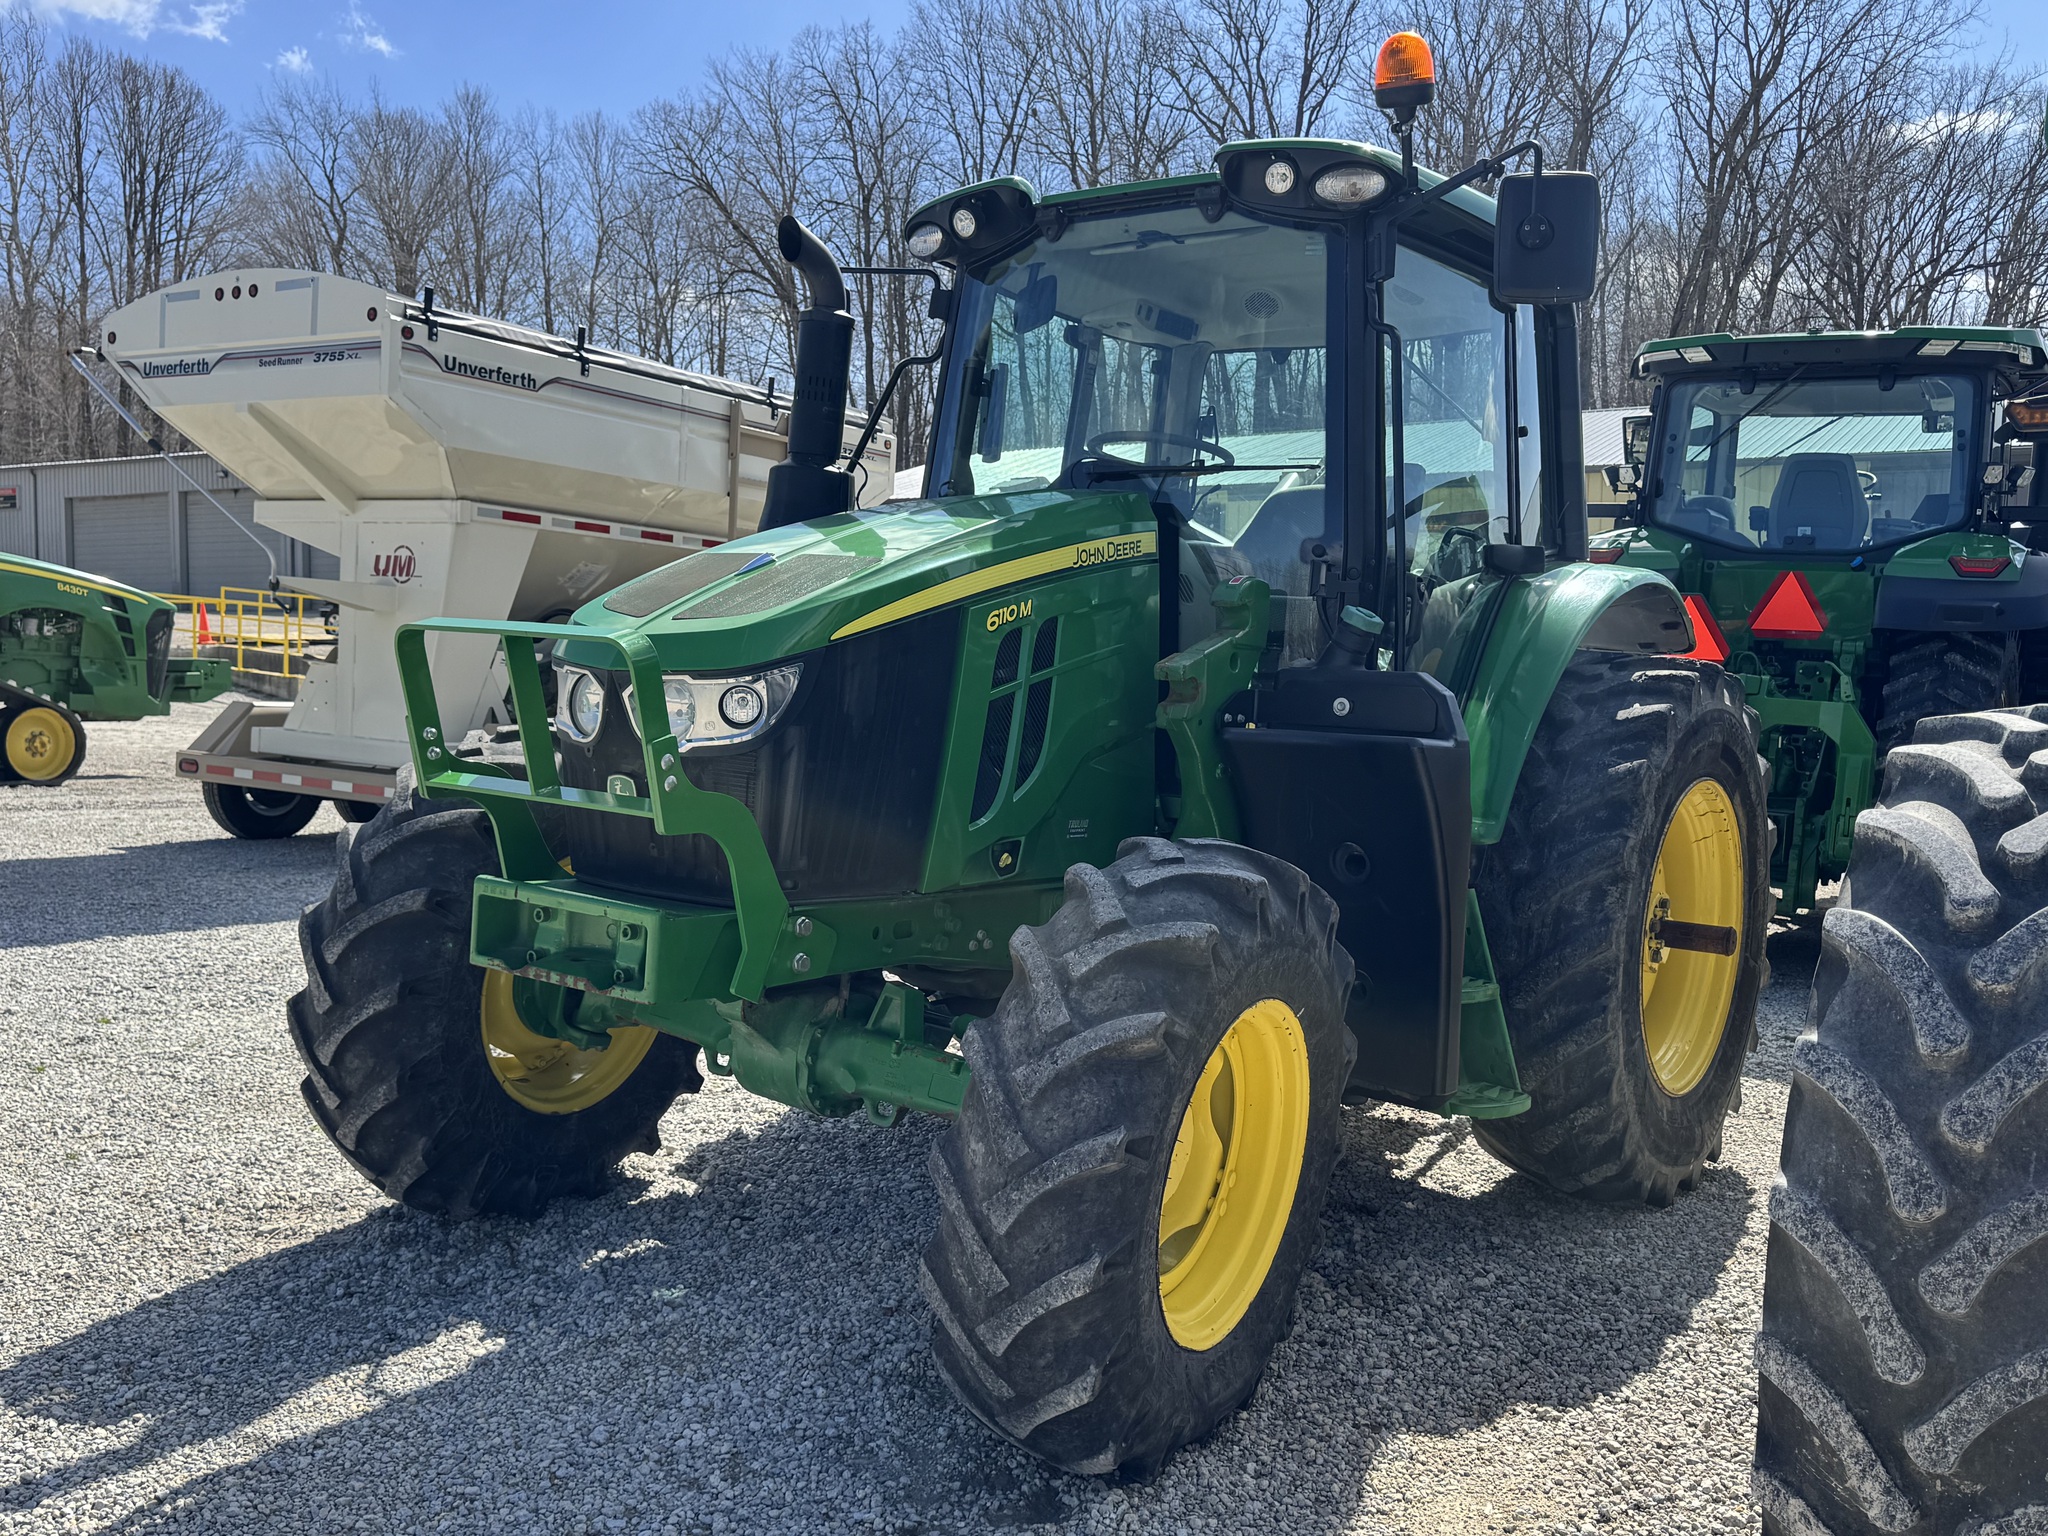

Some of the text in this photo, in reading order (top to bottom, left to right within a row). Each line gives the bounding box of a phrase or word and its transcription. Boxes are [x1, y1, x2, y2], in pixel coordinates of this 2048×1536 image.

[143, 358, 209, 376] Unverferth
[444, 354, 537, 389] Unverferth
[1072, 540, 1142, 566] JOHN DEERE
